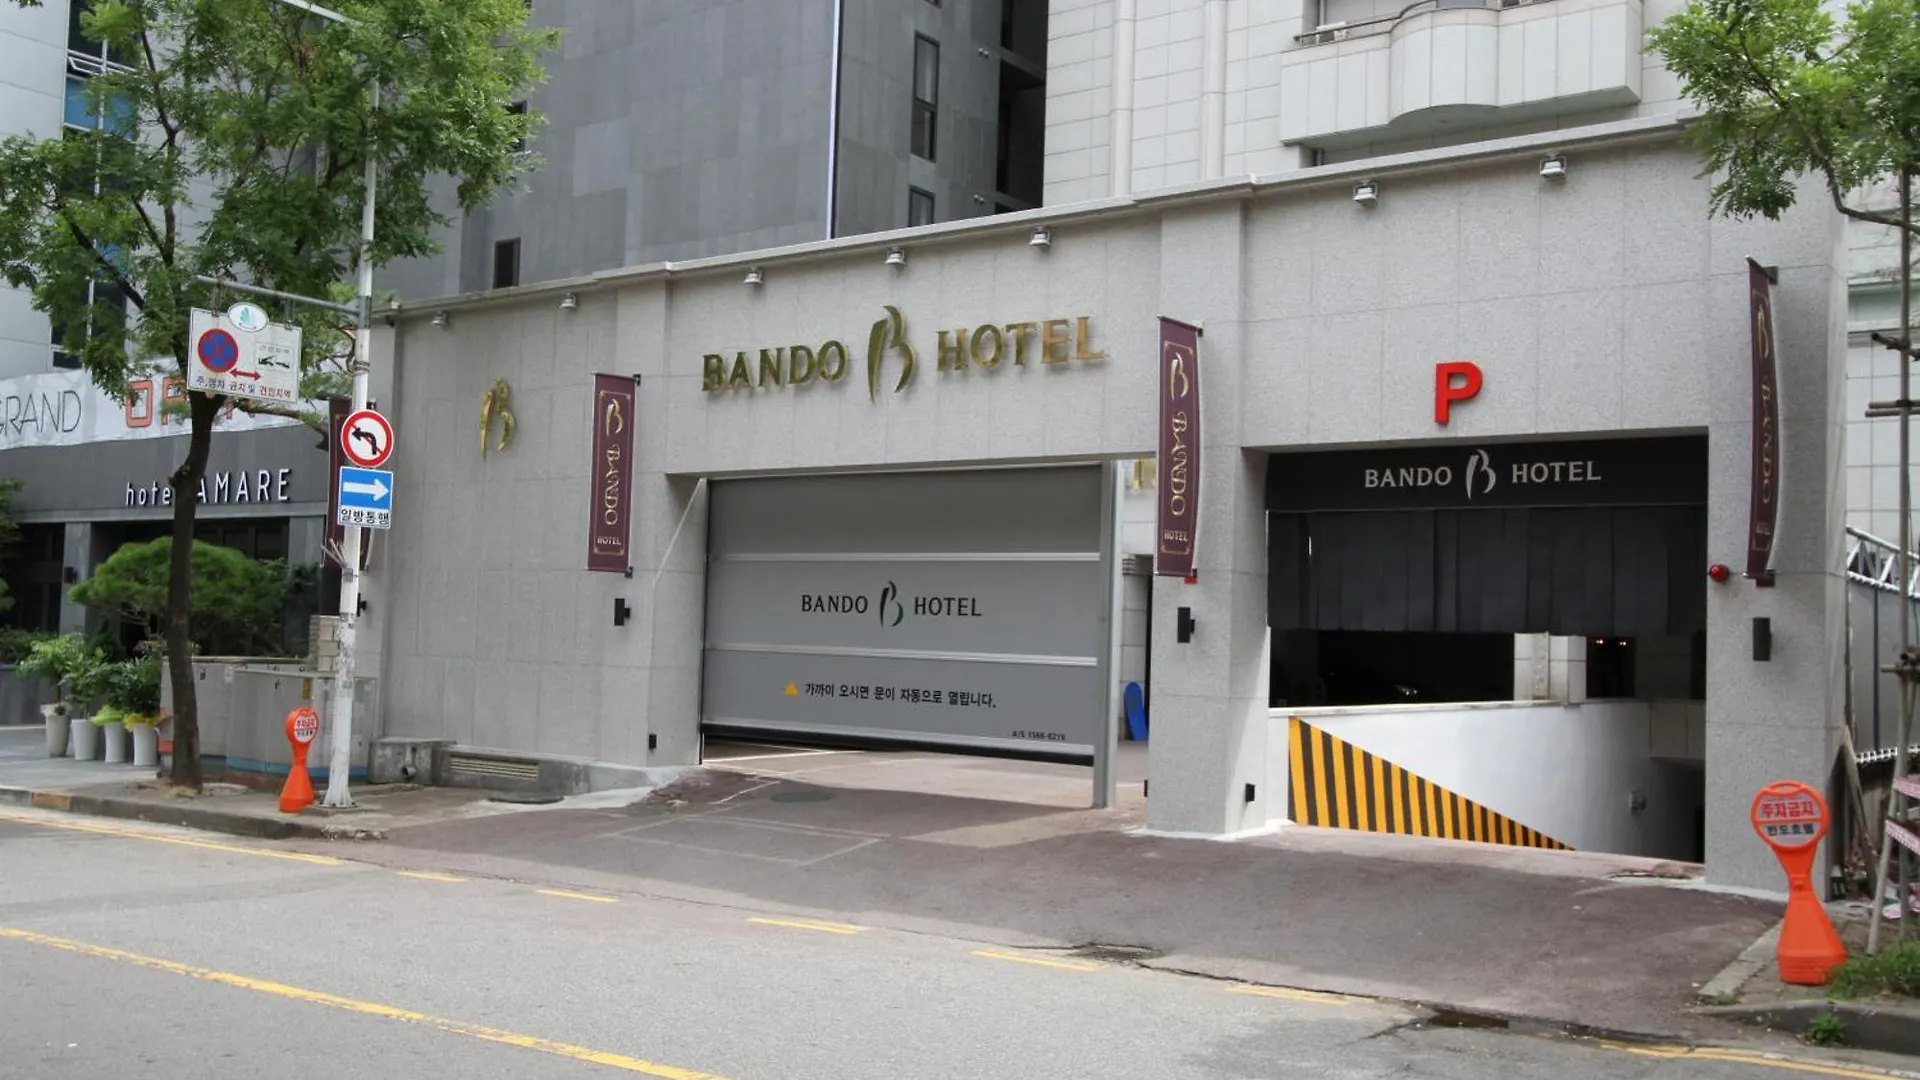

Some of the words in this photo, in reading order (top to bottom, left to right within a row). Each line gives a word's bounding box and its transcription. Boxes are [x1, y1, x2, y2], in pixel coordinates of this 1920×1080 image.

[702, 340, 848, 392] BANDO
[937, 316, 1107, 372] HOTEL
[229, 382, 246, 393] 금지
[1434, 362, 1483, 427] P
[1171, 411, 1188, 516] BANDO
[1364, 466, 1452, 488] BANDO
[1512, 461, 1602, 483] HOTEL
[126, 481, 174, 507] hote
[604, 444, 620, 526] BANDO
[342, 508, 389, 524] 일방통행
[801, 594, 869, 613] BANDO
[913, 596, 982, 616] HOTEL
[805, 683, 835, 697] 가까이
[838, 684, 869, 699] 오시면
[874, 686, 895, 701] 문이
[900, 688, 943, 704] 자동으로
[948, 691, 996, 708] 열립니다.
[1762, 801, 1814, 817] 주차금지
